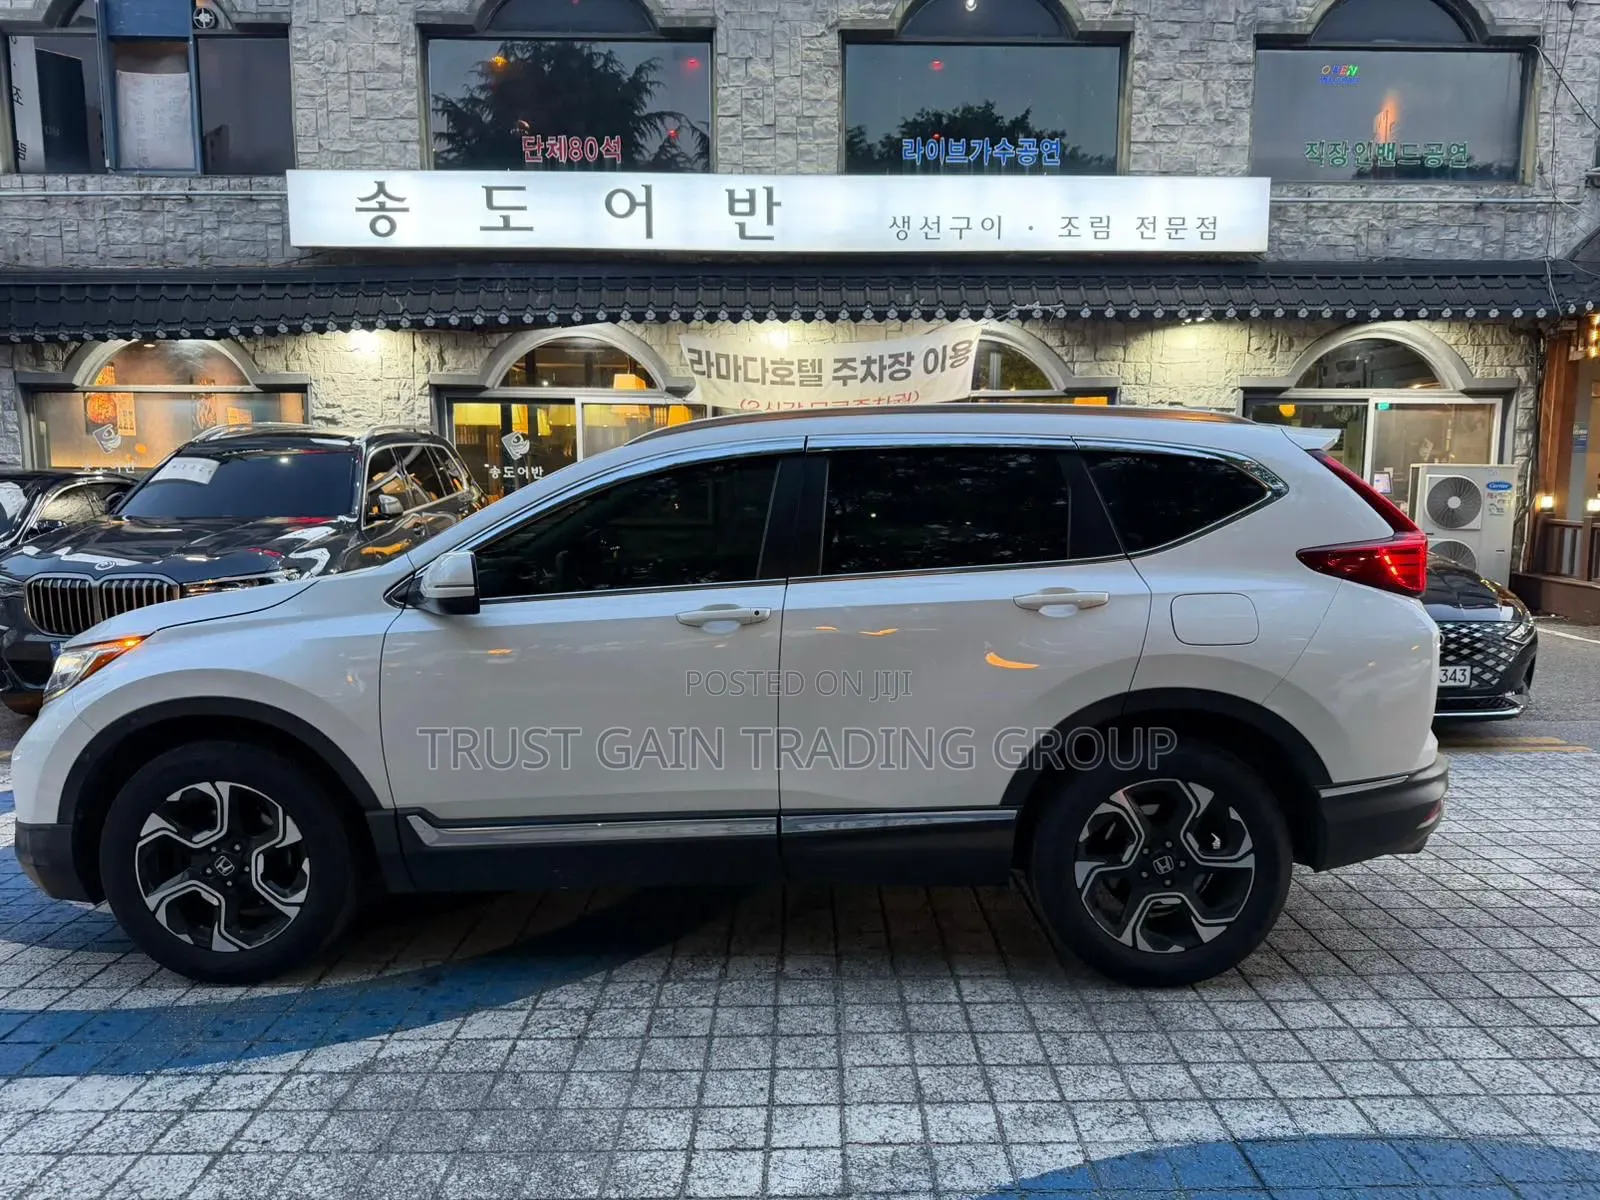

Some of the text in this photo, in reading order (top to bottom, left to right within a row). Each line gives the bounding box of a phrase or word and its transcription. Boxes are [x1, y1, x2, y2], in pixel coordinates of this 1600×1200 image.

[522, 134, 622, 164] 단체80석
[902, 137, 1061, 166] 라이브가수공연
[1304, 139, 1470, 168] 직장인밴드공연
[889, 215, 1002, 241] 생선구이
[1058, 215, 1112, 241] 조림
[1136, 215, 1217, 241] 전문점
[687, 339, 973, 387] 라마다호텔 주차장 이용
[489, 465, 544, 479] 송도어반
[1439, 668, 1467, 683] 343
